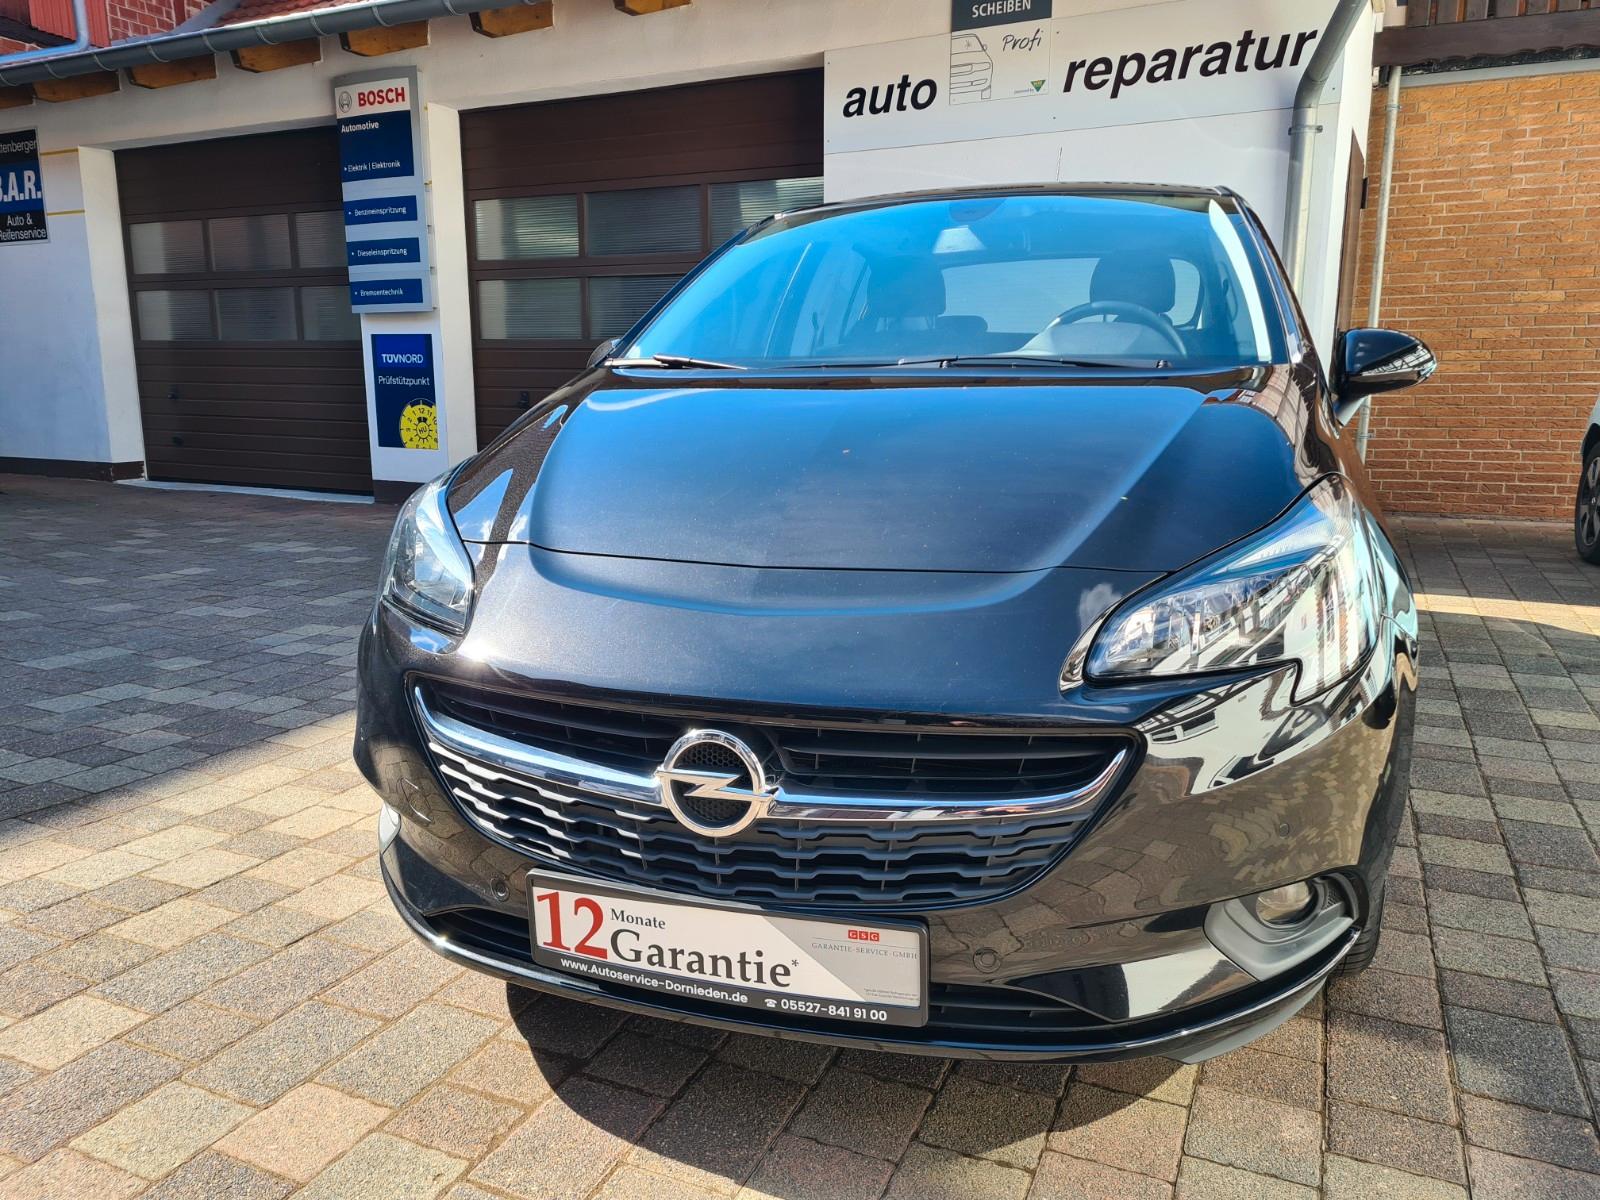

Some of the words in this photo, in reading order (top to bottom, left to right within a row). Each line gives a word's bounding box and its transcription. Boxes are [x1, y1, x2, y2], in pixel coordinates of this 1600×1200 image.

[971, 0, 1031, 18] SCHEIBEN
[1002, 28, 1043, 52] Profi
[843, 74, 938, 118] auto
[1063, 29, 1318, 99] reparatur
[358, 86, 406, 108] BOSCH
[341, 120, 380, 134] Automotive
[348, 163, 368, 173] Elektrik
[371, 159, 401, 170] Elektronik
[7, 214, 25, 226] Auto
[26, 212, 33, 226] &
[360, 287, 404, 297] Bremsentechnik
[378, 375, 430, 387] Prüfstützpunkt
[537, 892, 608, 960] 12
[610, 908, 666, 929] Monate
[847, 929, 880, 943] GSG
[560, 957, 749, 1004] www.Autoservice-Dornieden.de
[854, 1007, 867, 1019] 91
[870, 1009, 888, 1022] 00
